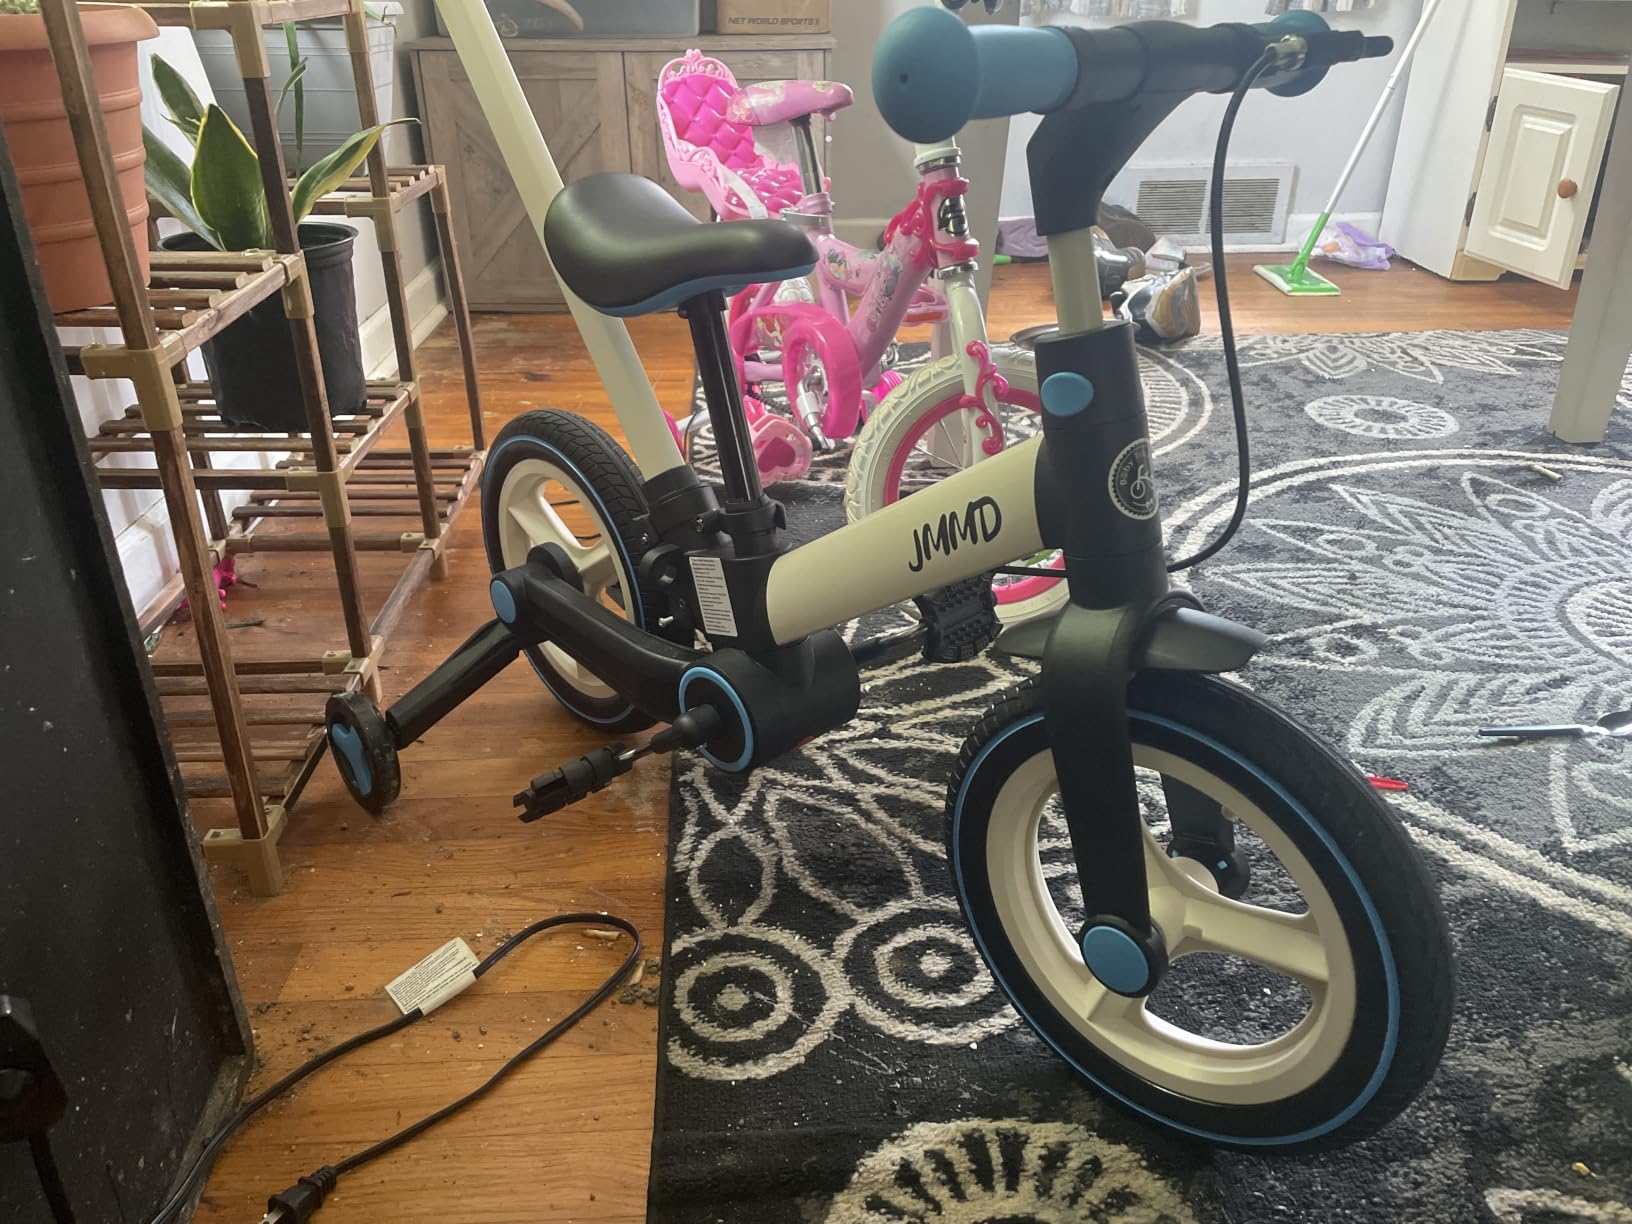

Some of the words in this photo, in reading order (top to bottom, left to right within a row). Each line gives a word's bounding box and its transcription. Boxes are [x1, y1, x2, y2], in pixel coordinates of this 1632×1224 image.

[728, 17, 746, 25] NET
[748, 17, 778, 25] WORLD
[780, 17, 815, 25] SPORTS
[909, 496, 1002, 572] JMMD
